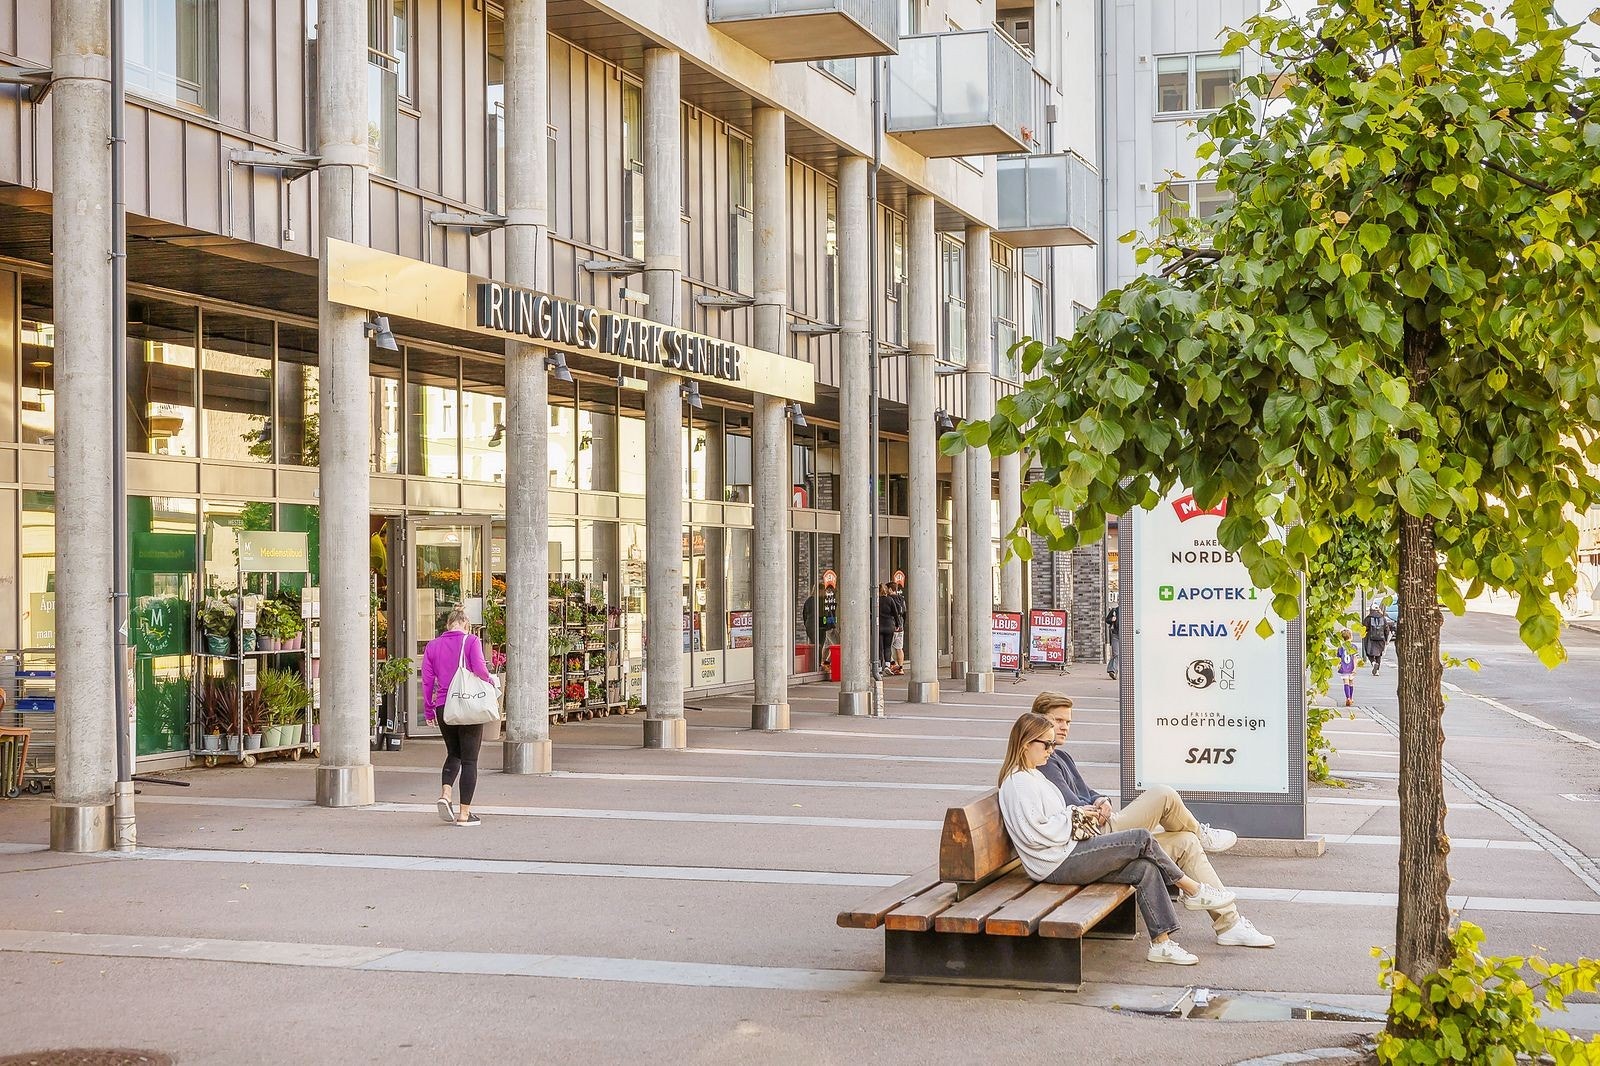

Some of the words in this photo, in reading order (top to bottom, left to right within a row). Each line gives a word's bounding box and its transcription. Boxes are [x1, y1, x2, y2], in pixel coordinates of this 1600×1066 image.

[488, 282, 599, 350] RINGNES
[610, 317, 664, 364] PARK
[672, 330, 742, 381] SENTER
[1193, 539, 1221, 547] BAKE
[1177, 587, 1246, 600] APOTEK
[1248, 587, 1257, 600] 1
[992, 619, 1018, 630] ILBUD
[1033, 615, 1063, 626] TILBUD
[451, 691, 486, 699] FLOYD
[1156, 715, 1266, 731] moderndesign
[1185, 747, 1237, 765] SATS
